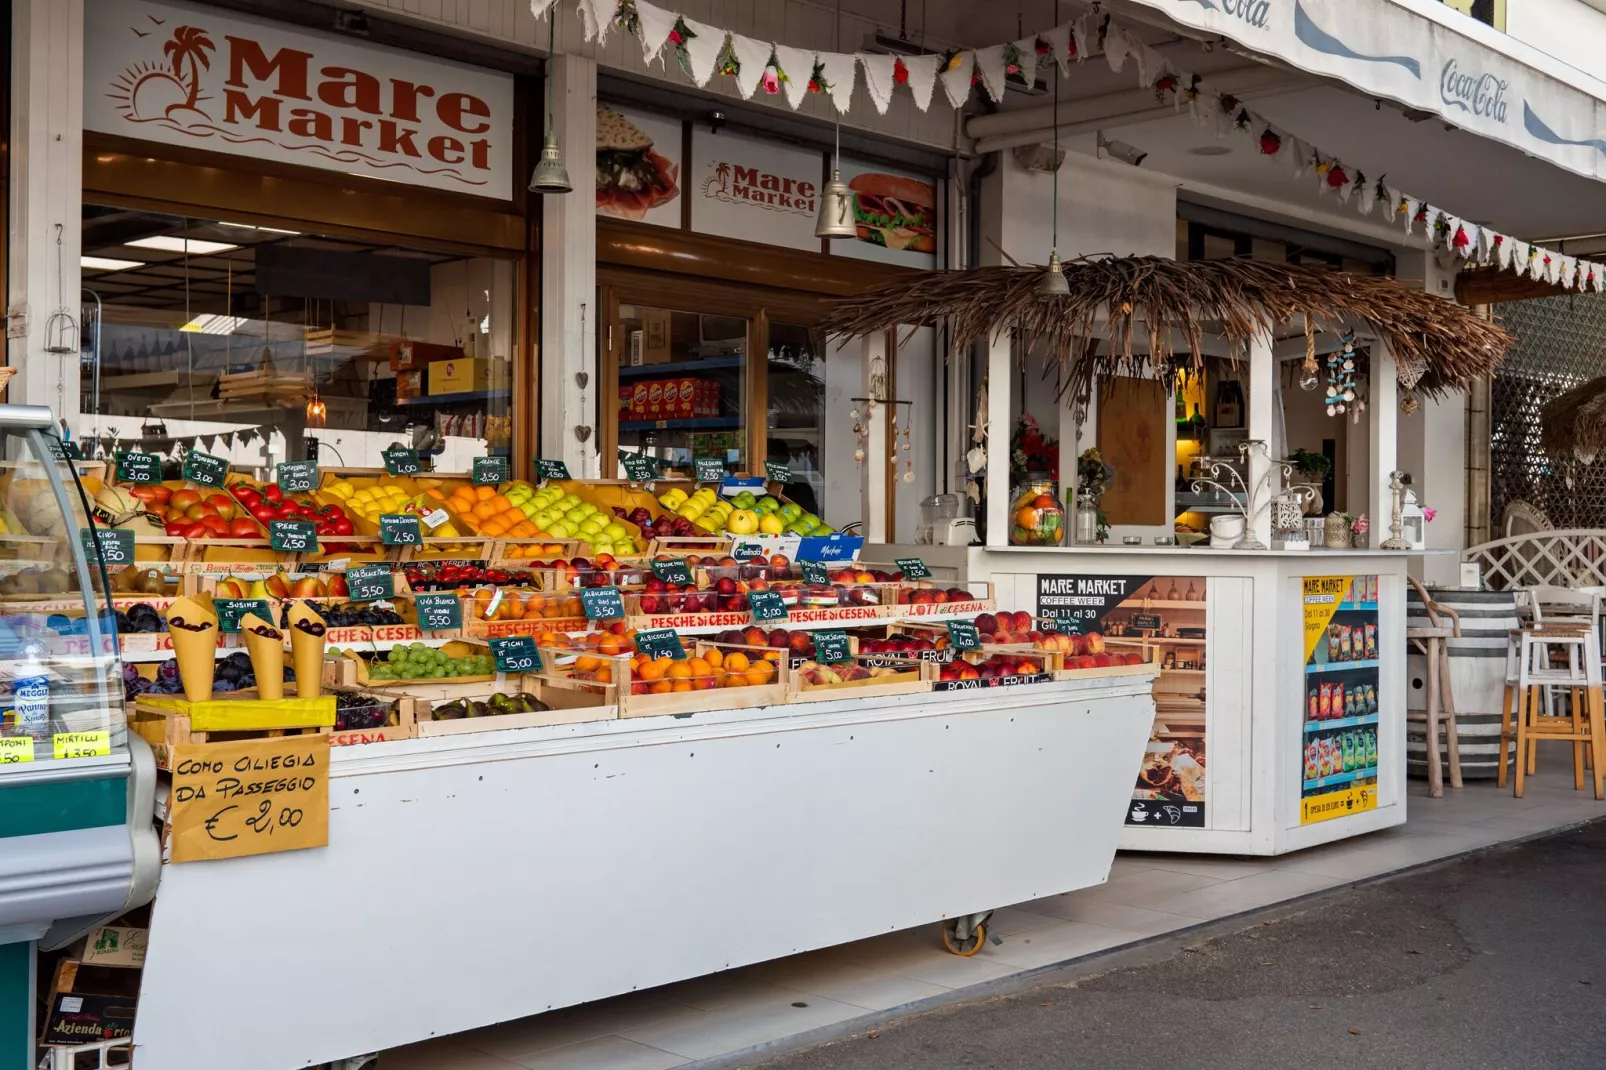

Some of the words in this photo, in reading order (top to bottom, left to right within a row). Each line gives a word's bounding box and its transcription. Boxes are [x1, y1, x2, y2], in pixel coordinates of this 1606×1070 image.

[224, 35, 491, 134] Mare
[222, 88, 492, 171] Market
[732, 164, 816, 199] Mare
[732, 183, 815, 213] Market
[128, 469, 150, 481] 3,00
[192, 471, 213, 483] 3,00
[288, 479, 310, 491] 3,00
[275, 522, 299, 530] PERE
[282, 538, 306, 550] 4,50
[393, 532, 415, 544] 4,50
[735, 546, 762, 557] Melinda
[1041, 579, 1074, 594] MARE
[1078, 580, 1127, 595] MARKET
[1304, 579, 1320, 593] MARE
[1321, 579, 1344, 593] MARKET
[360, 586, 385, 599] 5,50
[1040, 596, 1076, 606] COFFEE
[1078, 596, 1104, 606] WEEK
[594, 606, 615, 618] 3,50
[762, 608, 781, 618] 2,00
[947, 602, 983, 614] CESENA
[1042, 609, 1058, 618] Dal
[1085, 609, 1096, 619] 30
[428, 615, 451, 628] 5,50
[790, 610, 827, 623] PESCHE
[829, 611, 838, 620] di
[839, 608, 877, 620] CESENA
[487, 621, 539, 635] PESCHE
[651, 616, 696, 629] PESCHE
[697, 616, 707, 627] di
[1041, 621, 1058, 630] Giu
[327, 628, 357, 644] CHE
[360, 629, 373, 641] di
[640, 632, 674, 642] ALBICOCCHE
[826, 649, 843, 660] 5,00
[506, 657, 532, 669] 5,00
[947, 680, 982, 691] ROYAL
[56, 735, 99, 744] MIRTILLI
[234, 753, 317, 774] CILIEGIA
[176, 786, 206, 803] DA
[216, 776, 316, 801] PASSEGGIO
[205, 805, 239, 841] €
[246, 799, 304, 836] 2,00
[54, 1019, 102, 1035] Azienda
